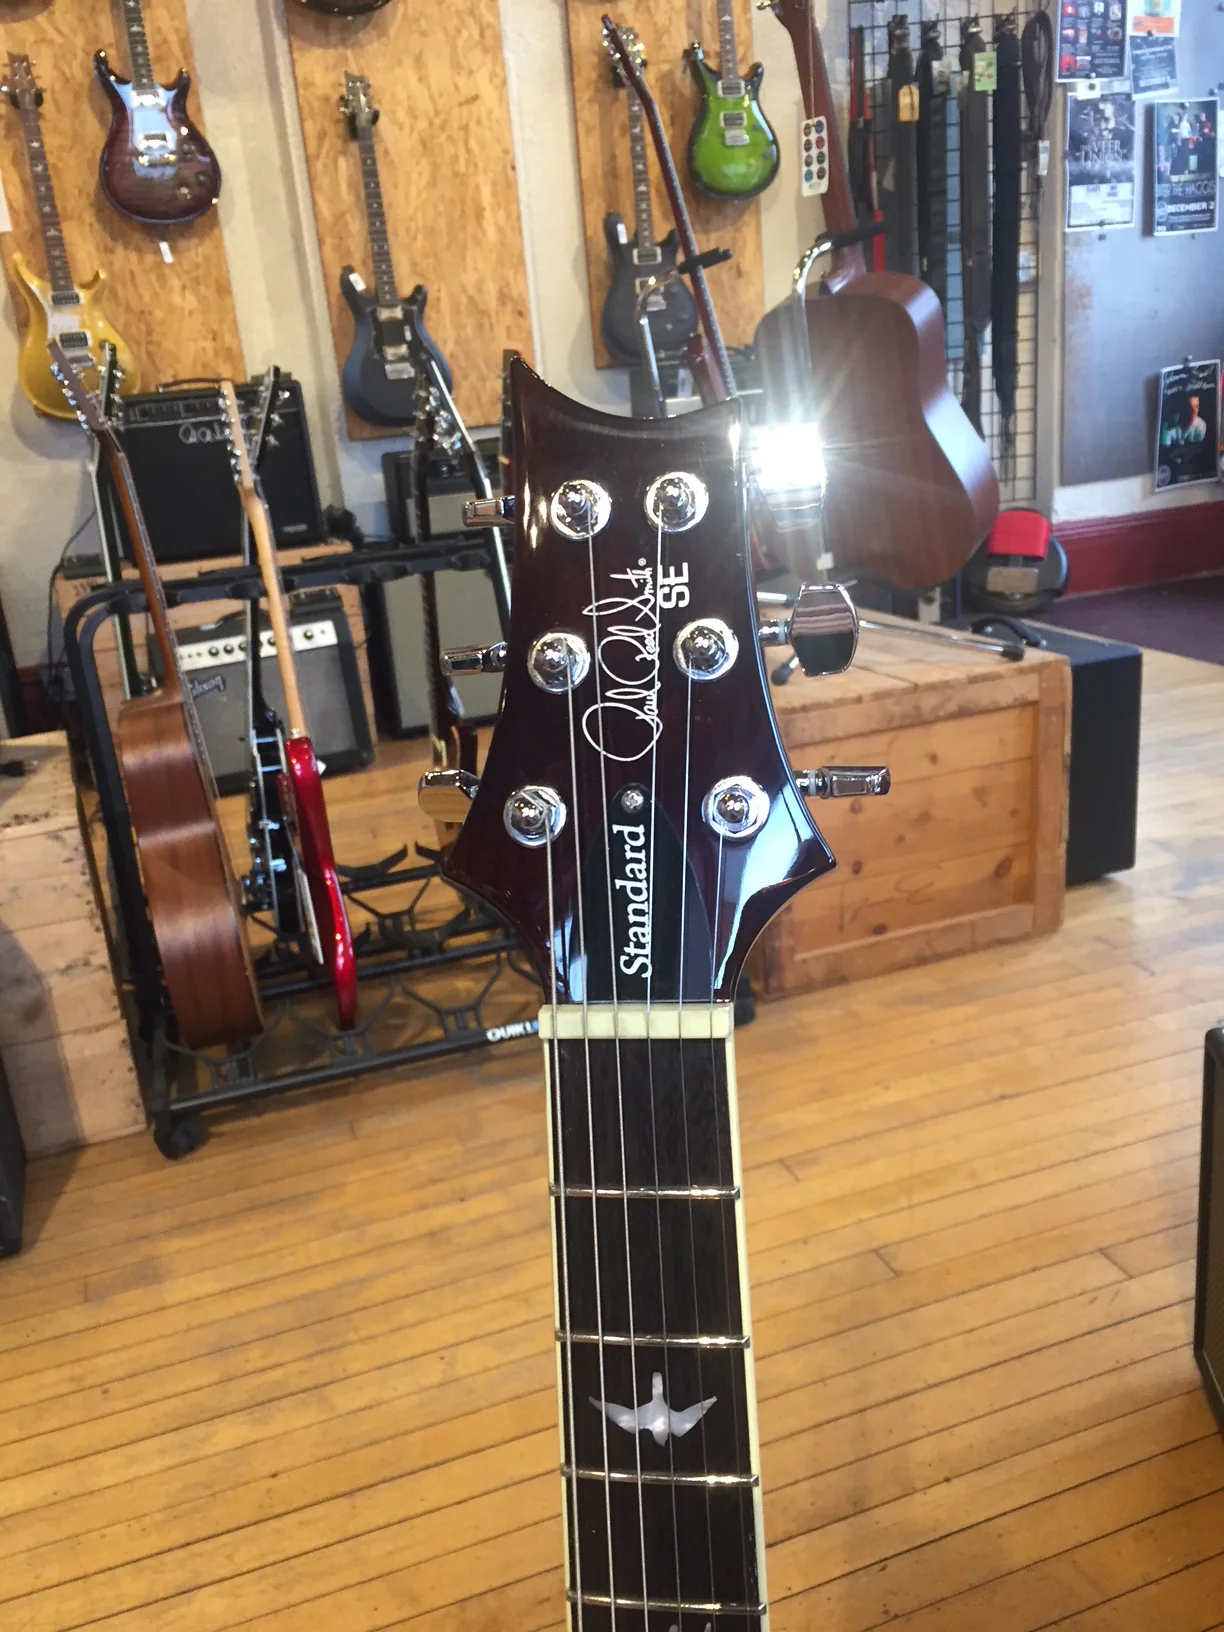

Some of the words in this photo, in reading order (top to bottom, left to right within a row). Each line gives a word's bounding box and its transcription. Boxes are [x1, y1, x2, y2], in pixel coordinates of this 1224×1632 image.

[1167, 202, 1208, 213] DECEMBER
[660, 562, 690, 609] SE
[611, 824, 652, 978] Standard
